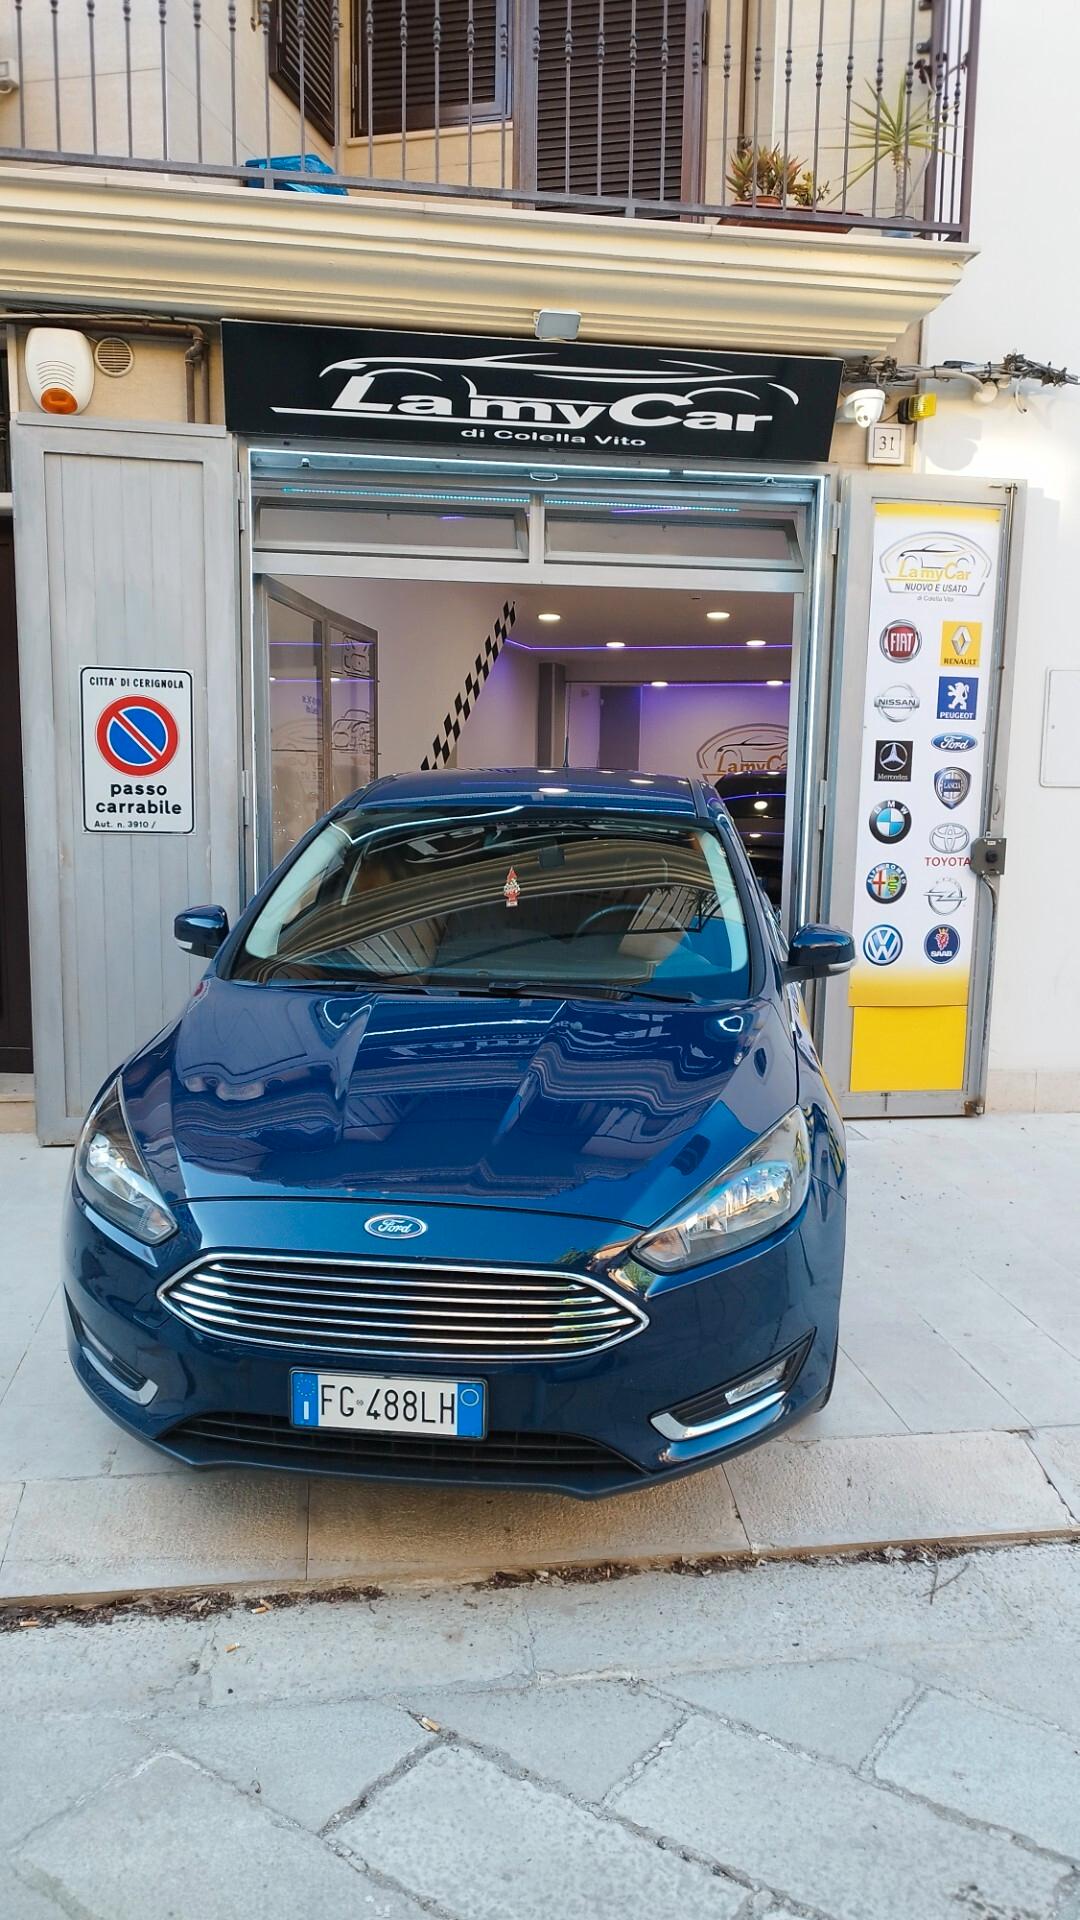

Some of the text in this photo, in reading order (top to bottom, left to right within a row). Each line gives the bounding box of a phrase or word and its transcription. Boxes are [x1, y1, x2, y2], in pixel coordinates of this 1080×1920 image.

[460, 429, 647, 446] di Colella Vito
[879, 436, 895, 451] 31
[904, 583, 968, 593] NUOVO E USATO
[890, 633, 914, 652] FIAT
[89, 677, 184, 689] CITTA' DI CERIGNOLA
[940, 711, 974, 719] PEUGEOT
[940, 735, 969, 750] Ford
[110, 784, 167, 797] passo
[96, 800, 182, 815] carrabile
[94, 820, 113, 828] Aut.
[925, 857, 972, 866] TOYOTA
[377, 1219, 413, 1233] Ford
